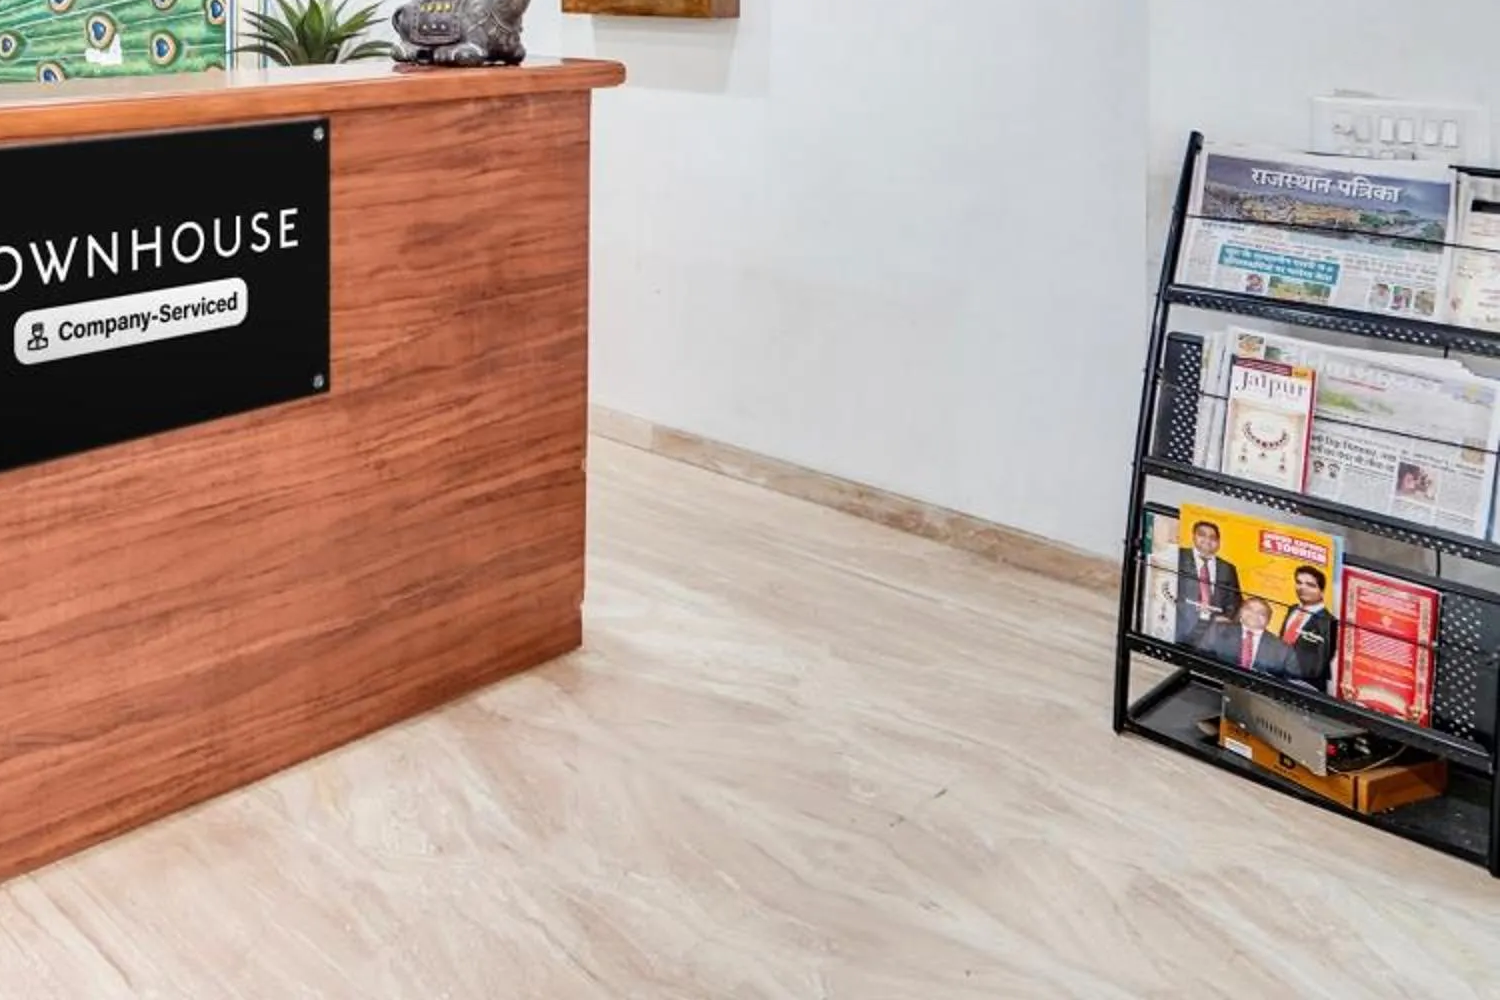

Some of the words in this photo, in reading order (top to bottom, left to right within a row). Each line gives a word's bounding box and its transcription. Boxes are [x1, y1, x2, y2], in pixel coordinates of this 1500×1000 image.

[1251, 166, 1333, 194] राजस्थान
[1337, 174, 1402, 203] पत्रिका
[57, 291, 239, 341] Company-Serviced
